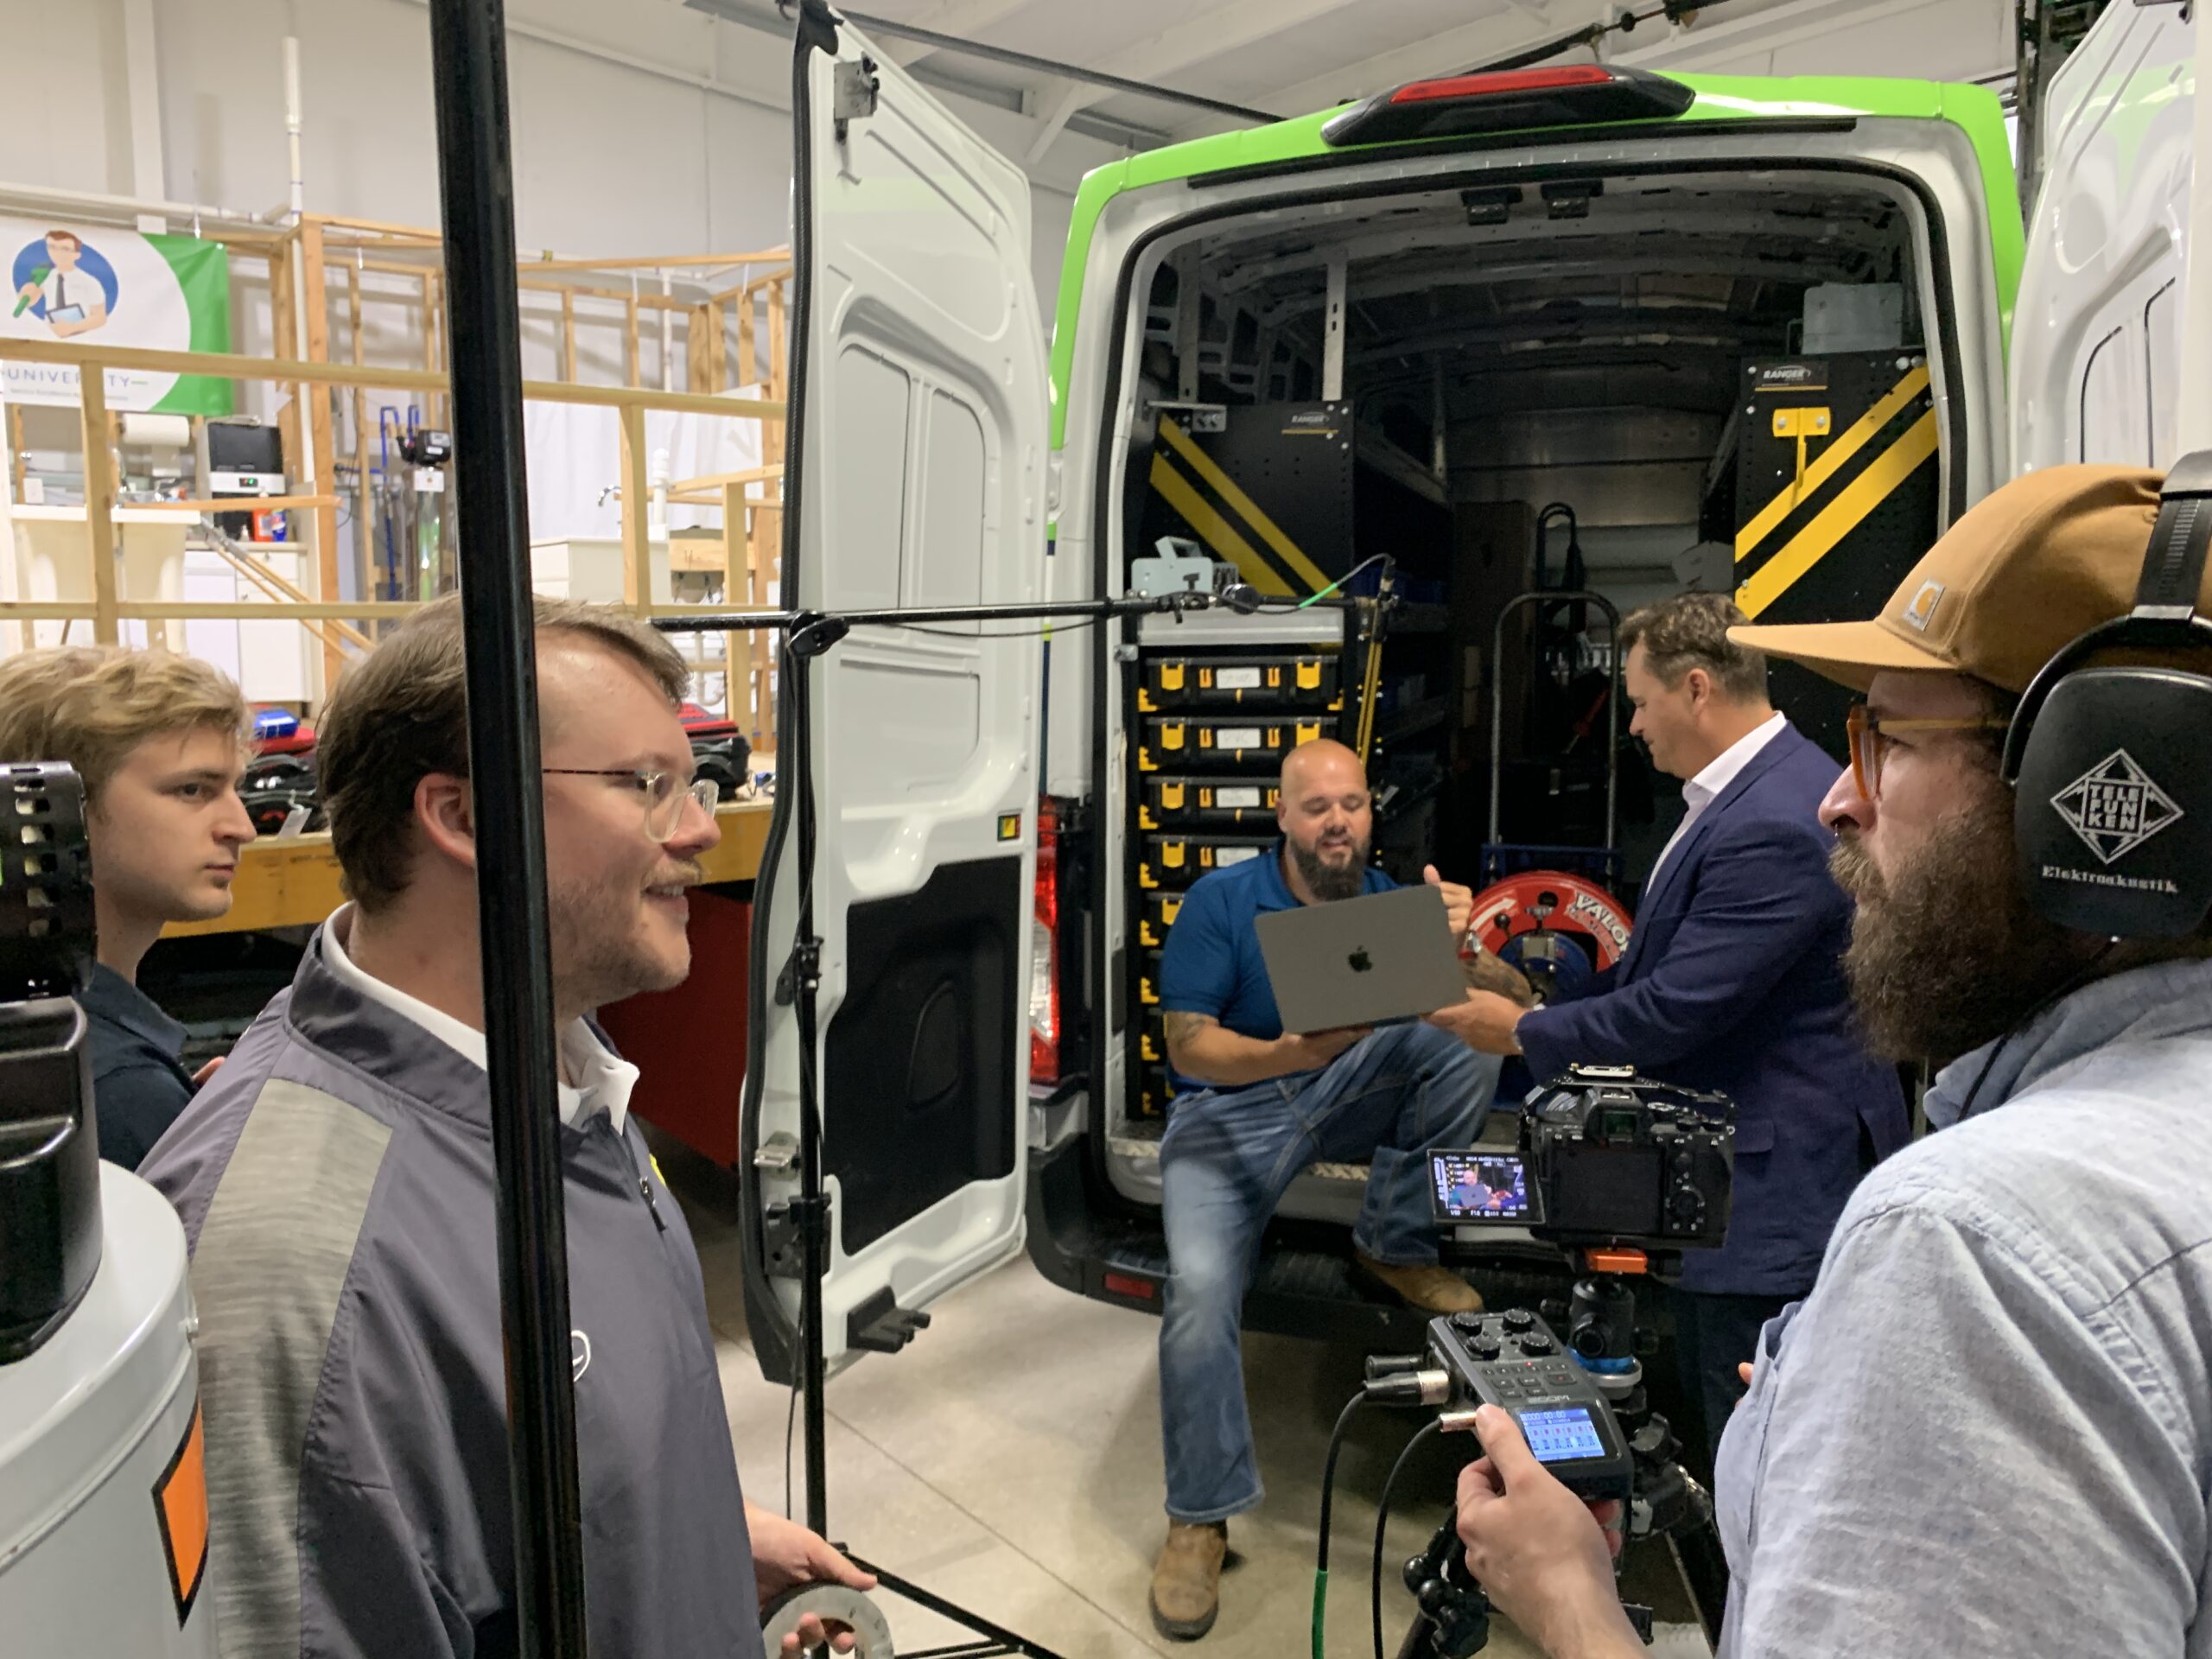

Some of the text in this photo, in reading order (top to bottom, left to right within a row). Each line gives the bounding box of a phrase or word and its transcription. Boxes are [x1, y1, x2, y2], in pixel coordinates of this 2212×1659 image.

[8, 368, 130, 387] UNIVETY
[2089, 785, 2140, 803] TELE
[2088, 798, 2139, 816] FUN
[2088, 813, 2138, 830] KEN
